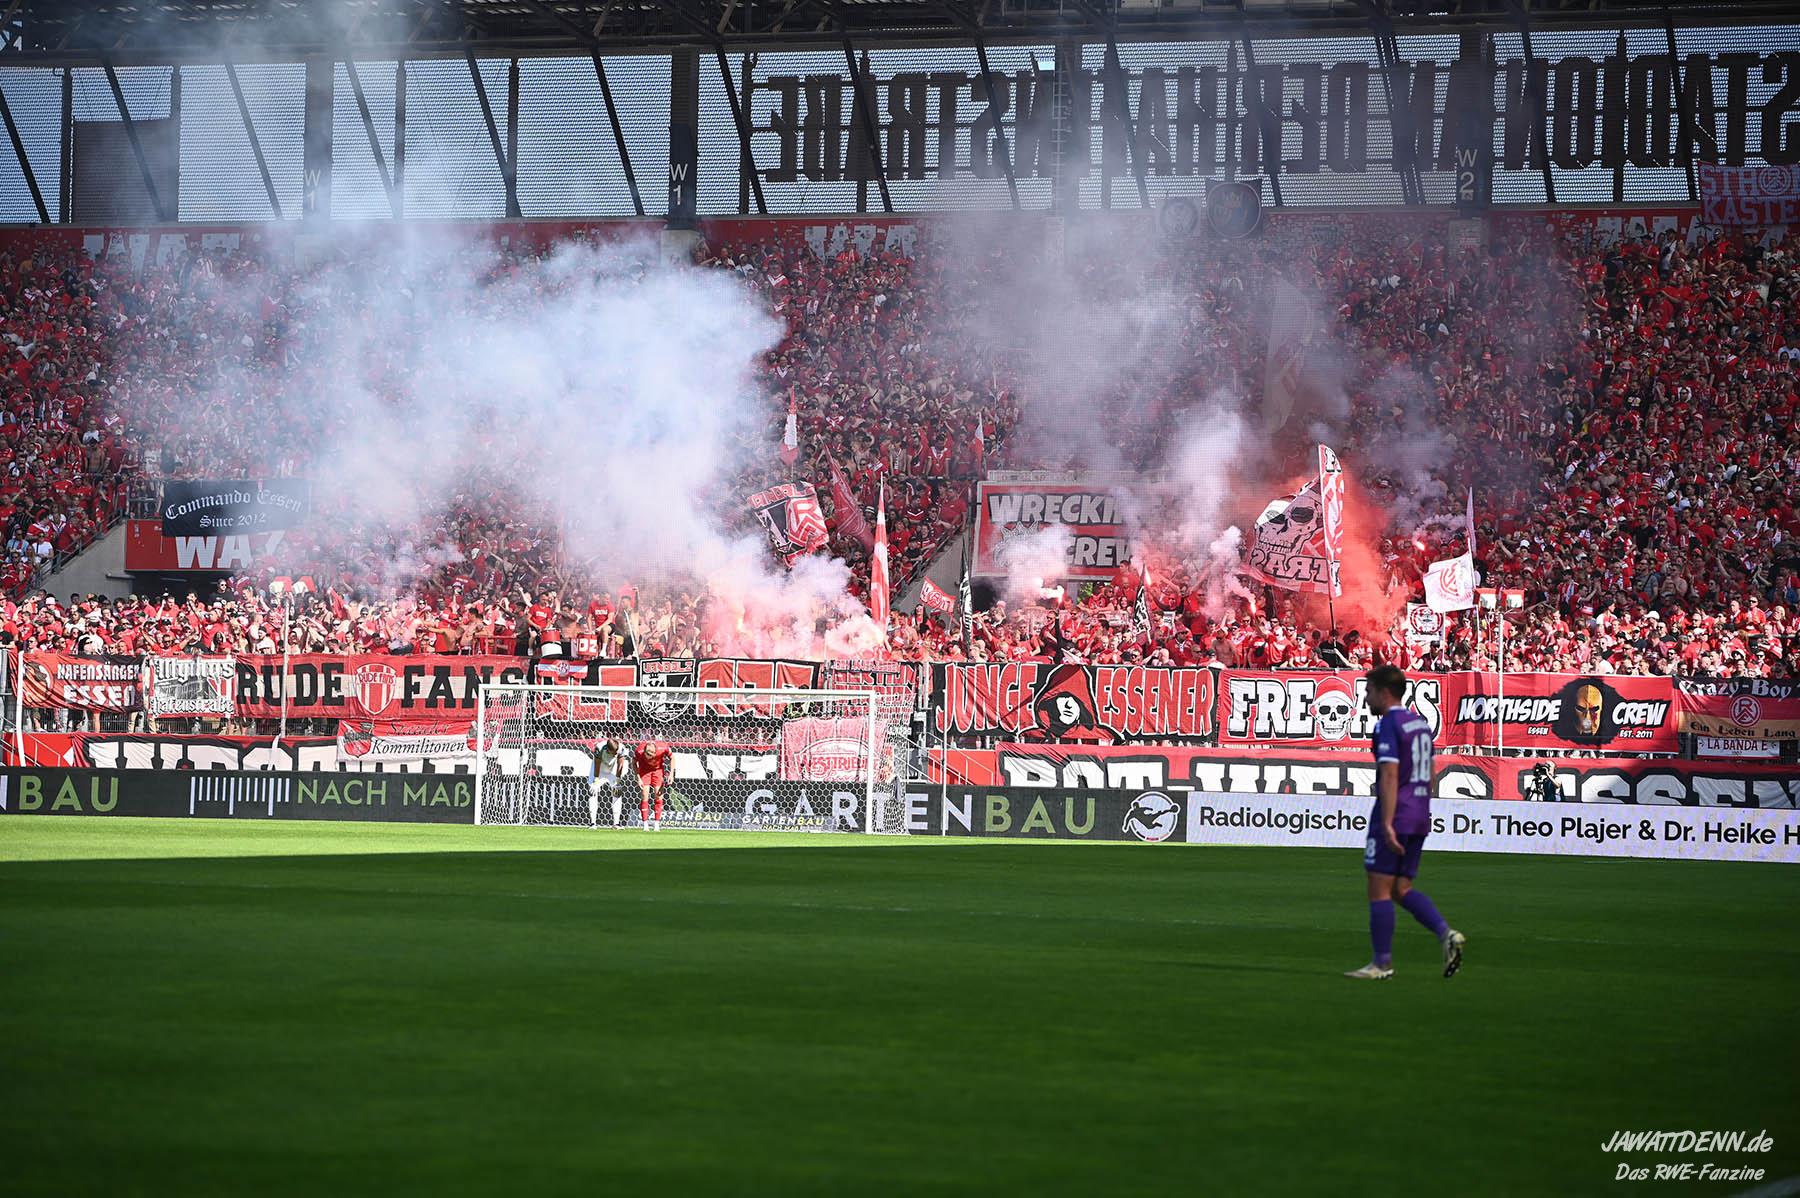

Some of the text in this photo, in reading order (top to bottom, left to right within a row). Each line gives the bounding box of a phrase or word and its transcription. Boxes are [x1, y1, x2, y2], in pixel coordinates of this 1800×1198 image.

[668, 162, 689, 182] W
[165, 489, 305, 521] Commando Essen
[199, 511, 267, 529] Since 2012
[153, 657, 236, 684] Mythos
[63, 683, 136, 707] ESSEN
[236, 662, 345, 707] RUDE
[936, 662, 1038, 734] JUNGE
[1096, 666, 1214, 737] ESSENER
[1458, 697, 1667, 727] NORTHSIDE CREW
[372, 737, 466, 755] Kommilitonen
[1527, 726, 1653, 739] ESSEN EST. 2011
[1707, 739, 1720, 750] LA
[1723, 739, 1758, 751] BANDA
[1410, 732, 1432, 783] 18
[297, 779, 387, 806] NACH
[1200, 806, 1367, 834] Radiologische
[1452, 814, 1484, 835] Dr.
[1491, 815, 1554, 837] Theo
[1560, 817, 1632, 846] Plajer
[1638, 819, 1657, 841] &
[1664, 820, 1696, 842] Dr.
[1704, 822, 1777, 845] Heike
